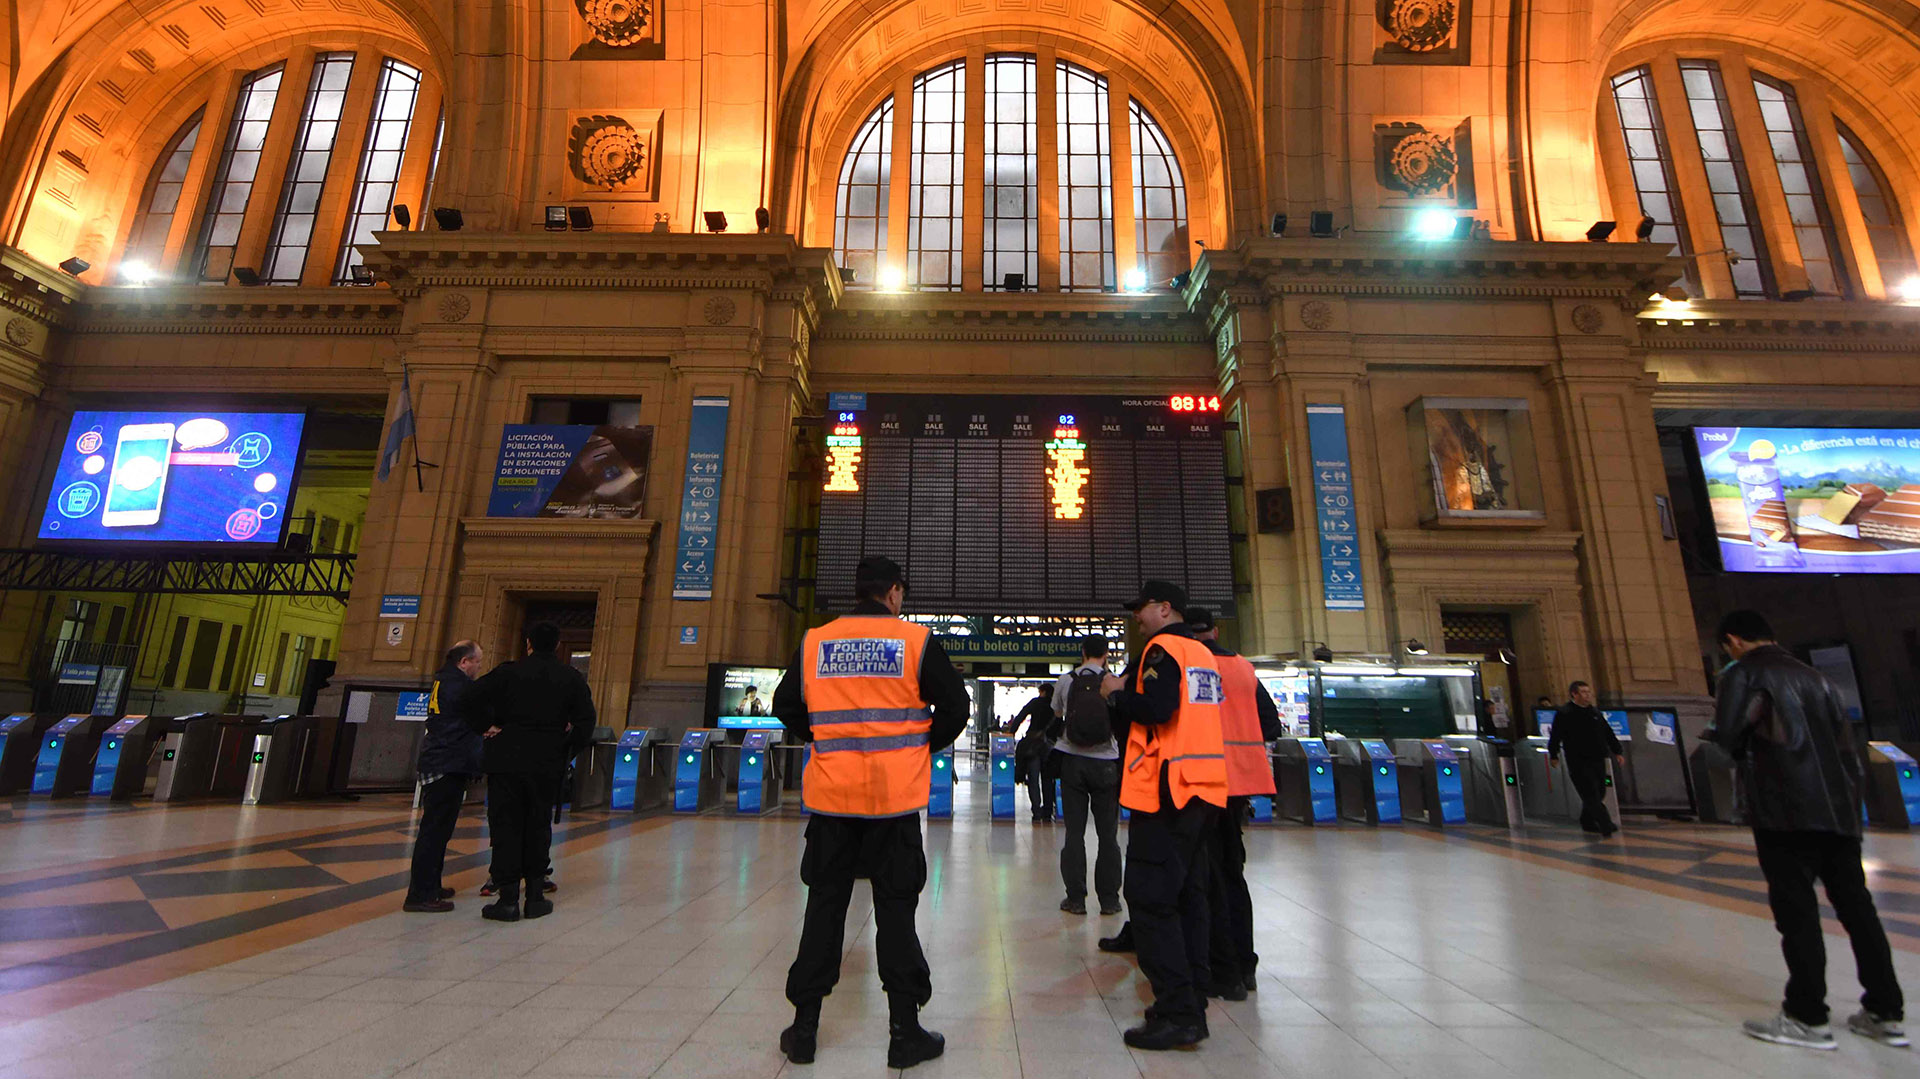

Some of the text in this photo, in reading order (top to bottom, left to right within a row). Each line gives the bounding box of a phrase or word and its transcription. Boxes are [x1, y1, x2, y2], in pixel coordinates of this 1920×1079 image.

[1170, 396, 1220, 411] 08 14
[839, 412, 855, 422] 04
[1059, 415, 1075, 425] 02
[506, 442, 541, 450] PÚBLICA
[1800, 436, 1854, 452] diferencia
[1855, 435, 1878, 447] está
[1879, 437, 1895, 447] en
[1896, 436, 1908, 448] el
[517, 450, 572, 458] INSTALACIÓN
[940, 638, 1083, 654] hibí tu boleto al ingresar
[830, 652, 888, 663] FEDERAL
[822, 662, 898, 673] ARGENTINA
